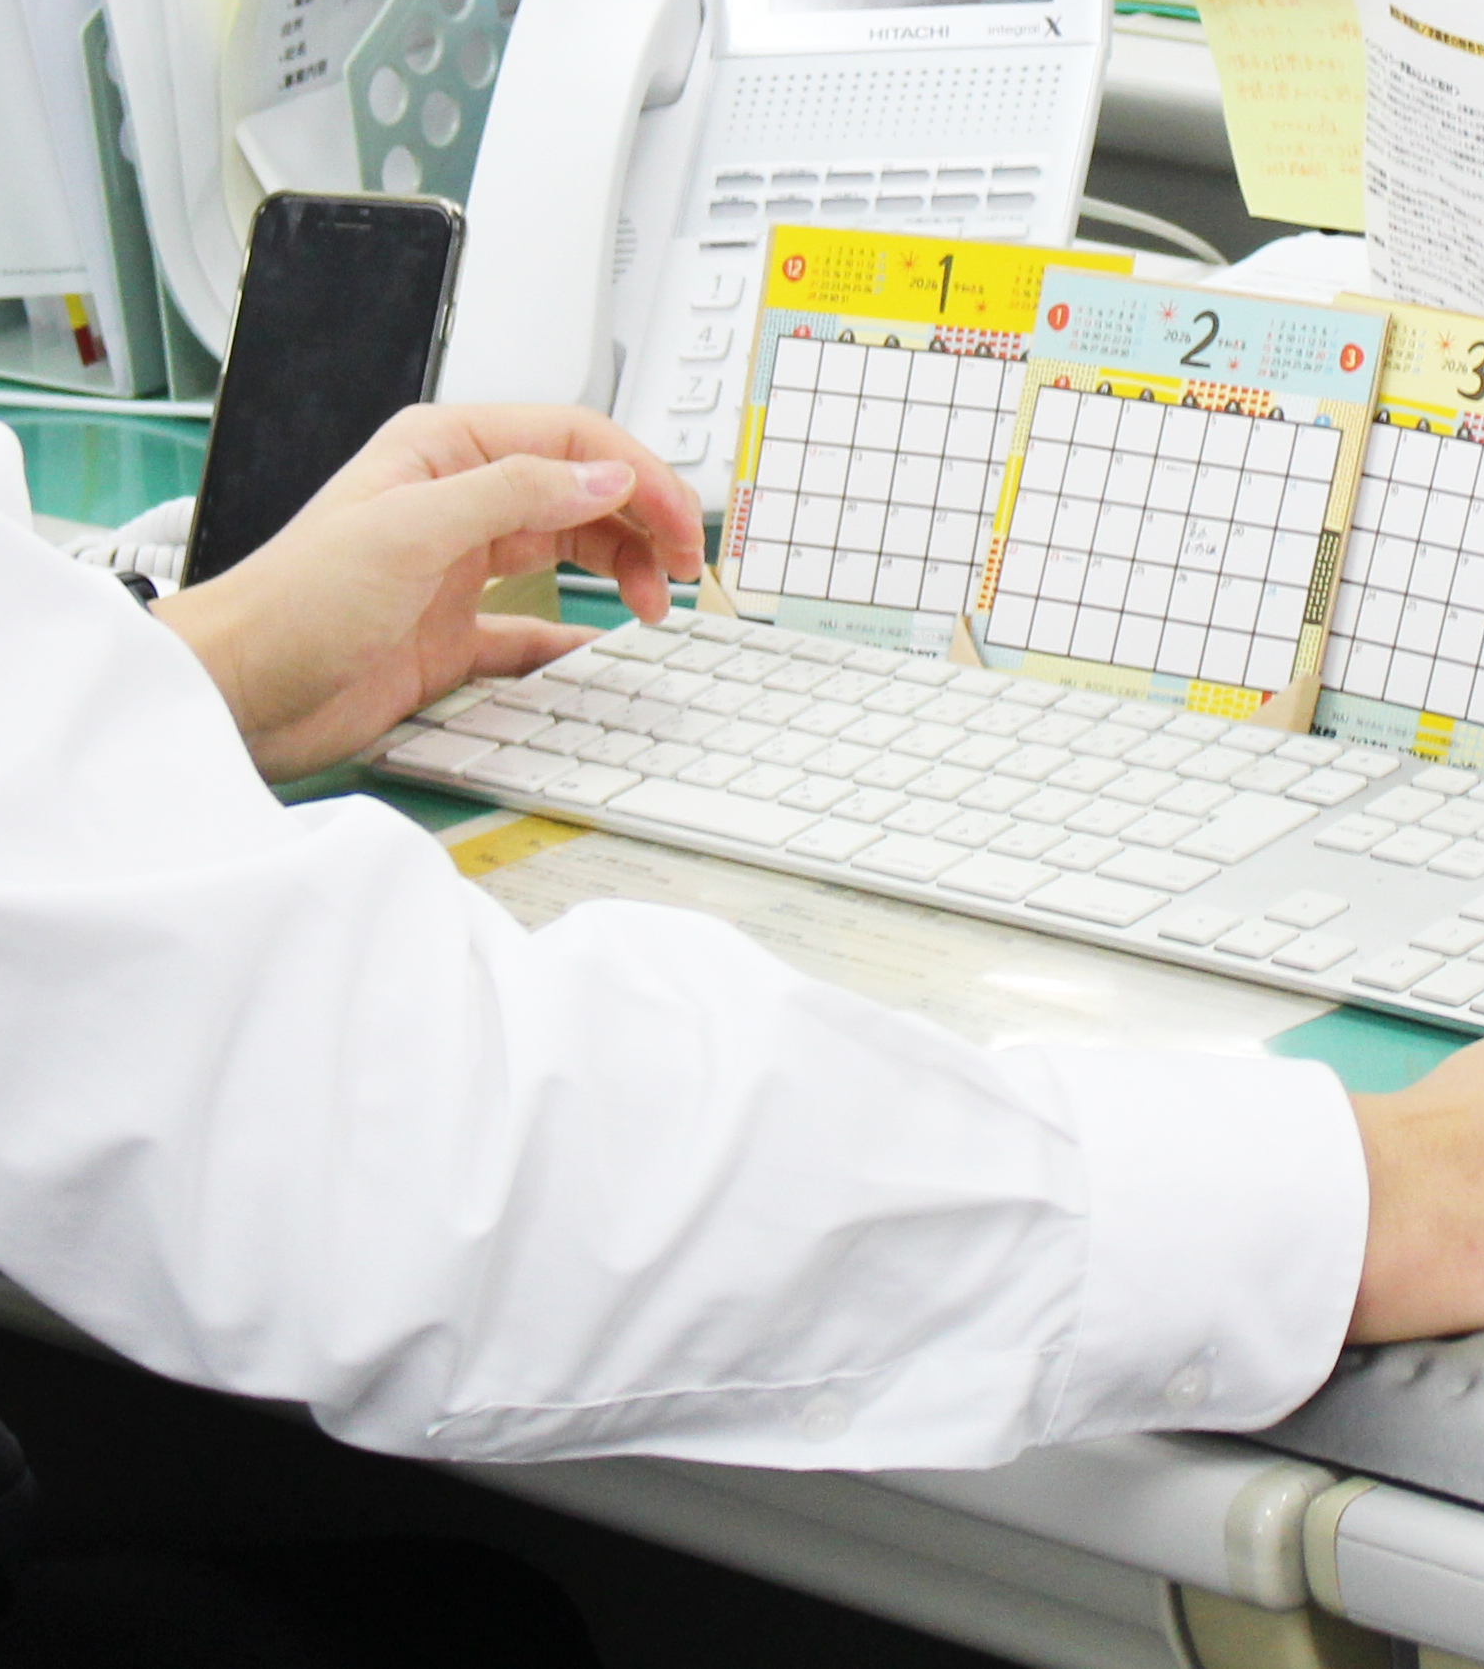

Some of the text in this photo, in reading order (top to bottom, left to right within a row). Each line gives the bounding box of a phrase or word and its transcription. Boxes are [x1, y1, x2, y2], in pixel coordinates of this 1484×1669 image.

[869, 15, 1064, 41] HITACHI integral X
[787, 260, 803, 277] 12
[908, 278, 937, 291] 2026
[938, 253, 954, 314] 1
[1163, 329, 1191, 344] 2026
[1180, 309, 1220, 369] 2
[1441, 358, 1468, 375] 2026
